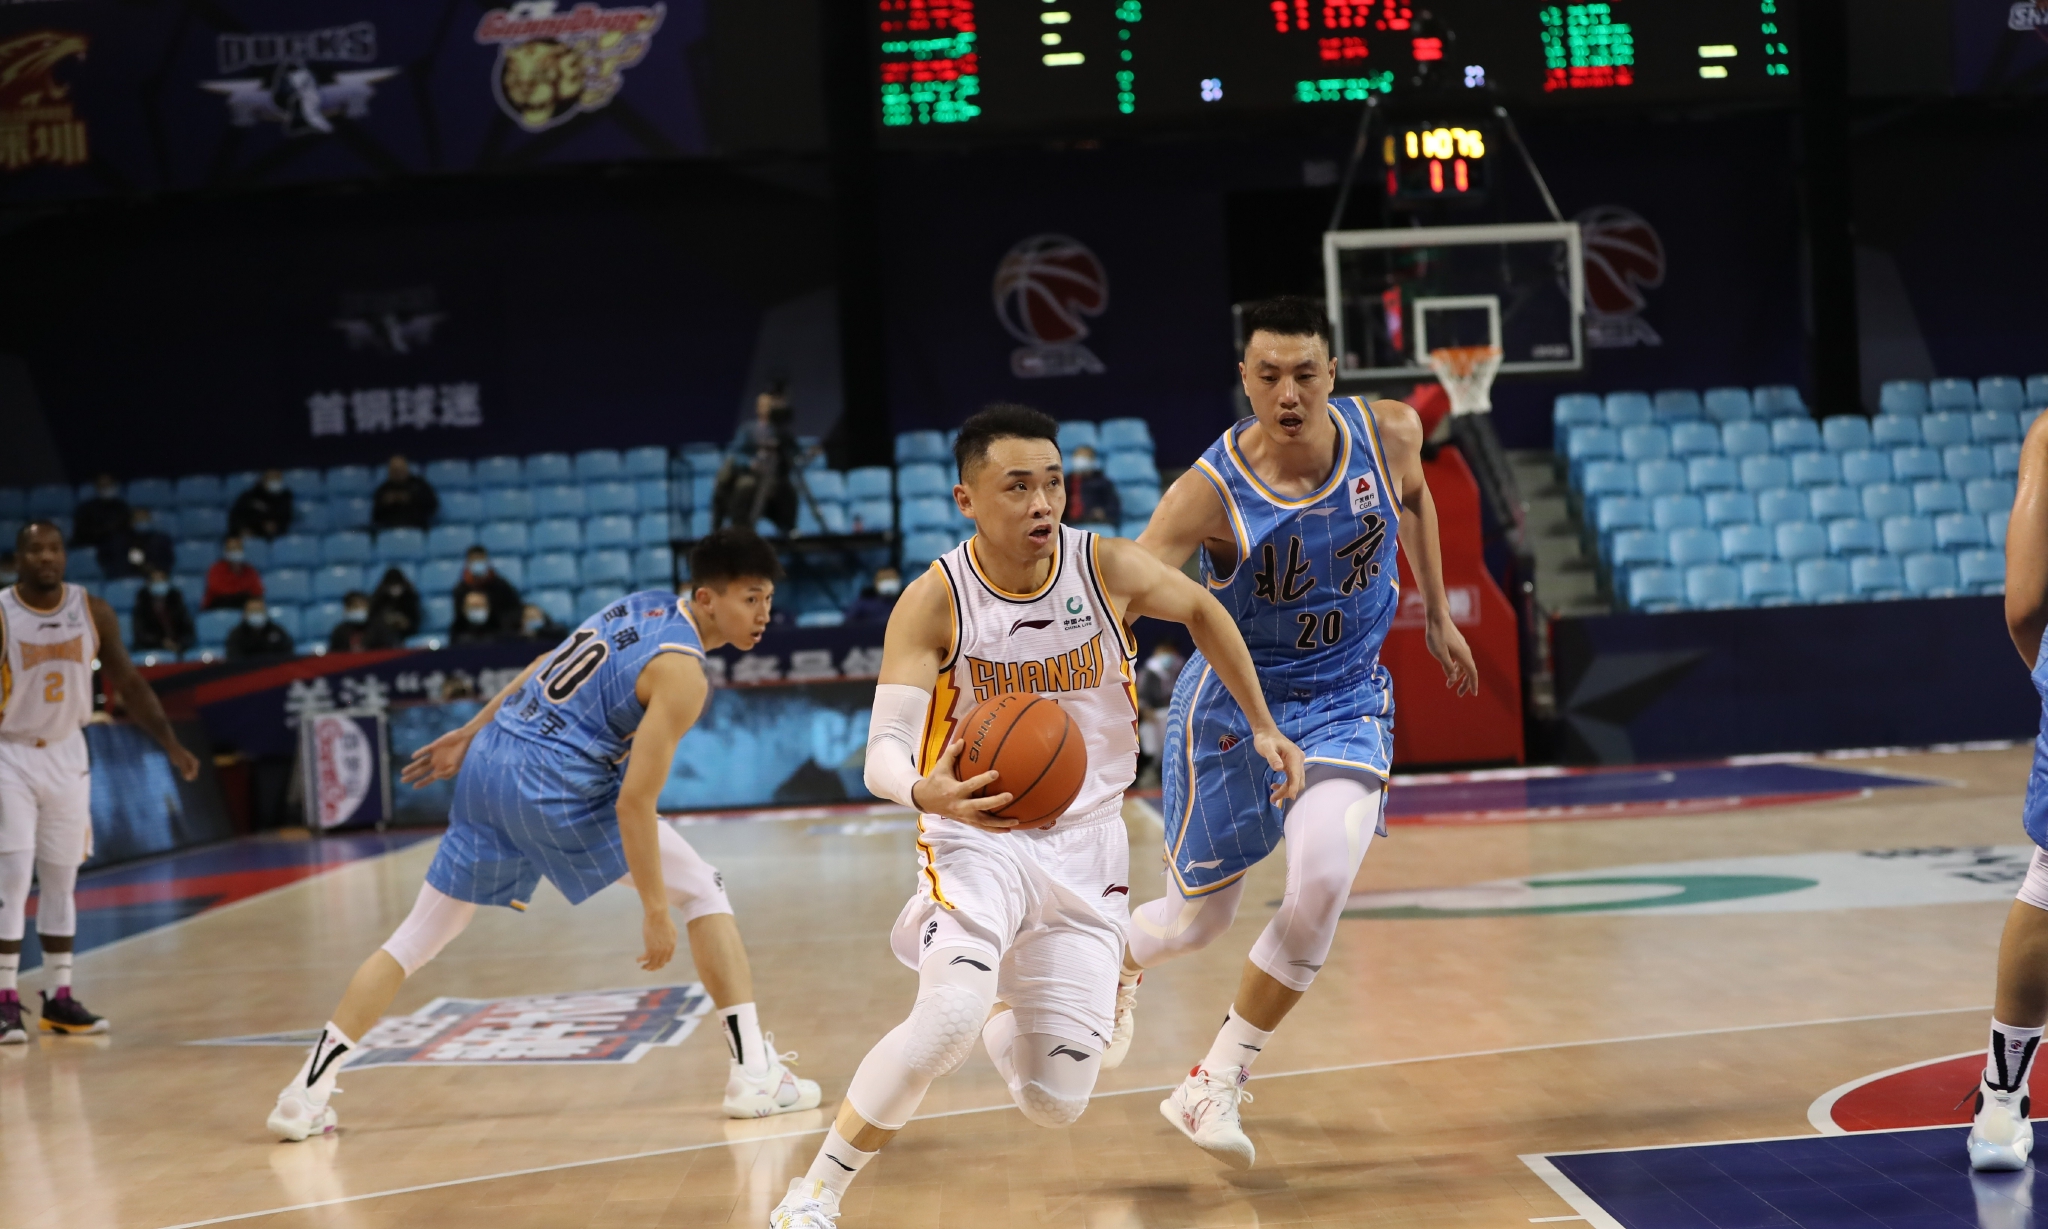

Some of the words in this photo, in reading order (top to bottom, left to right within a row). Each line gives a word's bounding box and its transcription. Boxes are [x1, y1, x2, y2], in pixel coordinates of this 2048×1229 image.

[1359, 501, 1373, 510] CGB
[1254, 513, 1387, 604] 北京
[1295, 609, 1343, 650] 20
[44, 671, 65, 704] 2
[536, 628, 609, 704] 10
[964, 629, 1104, 704] SHANXI
[967, 695, 1018, 764] LI-NING
